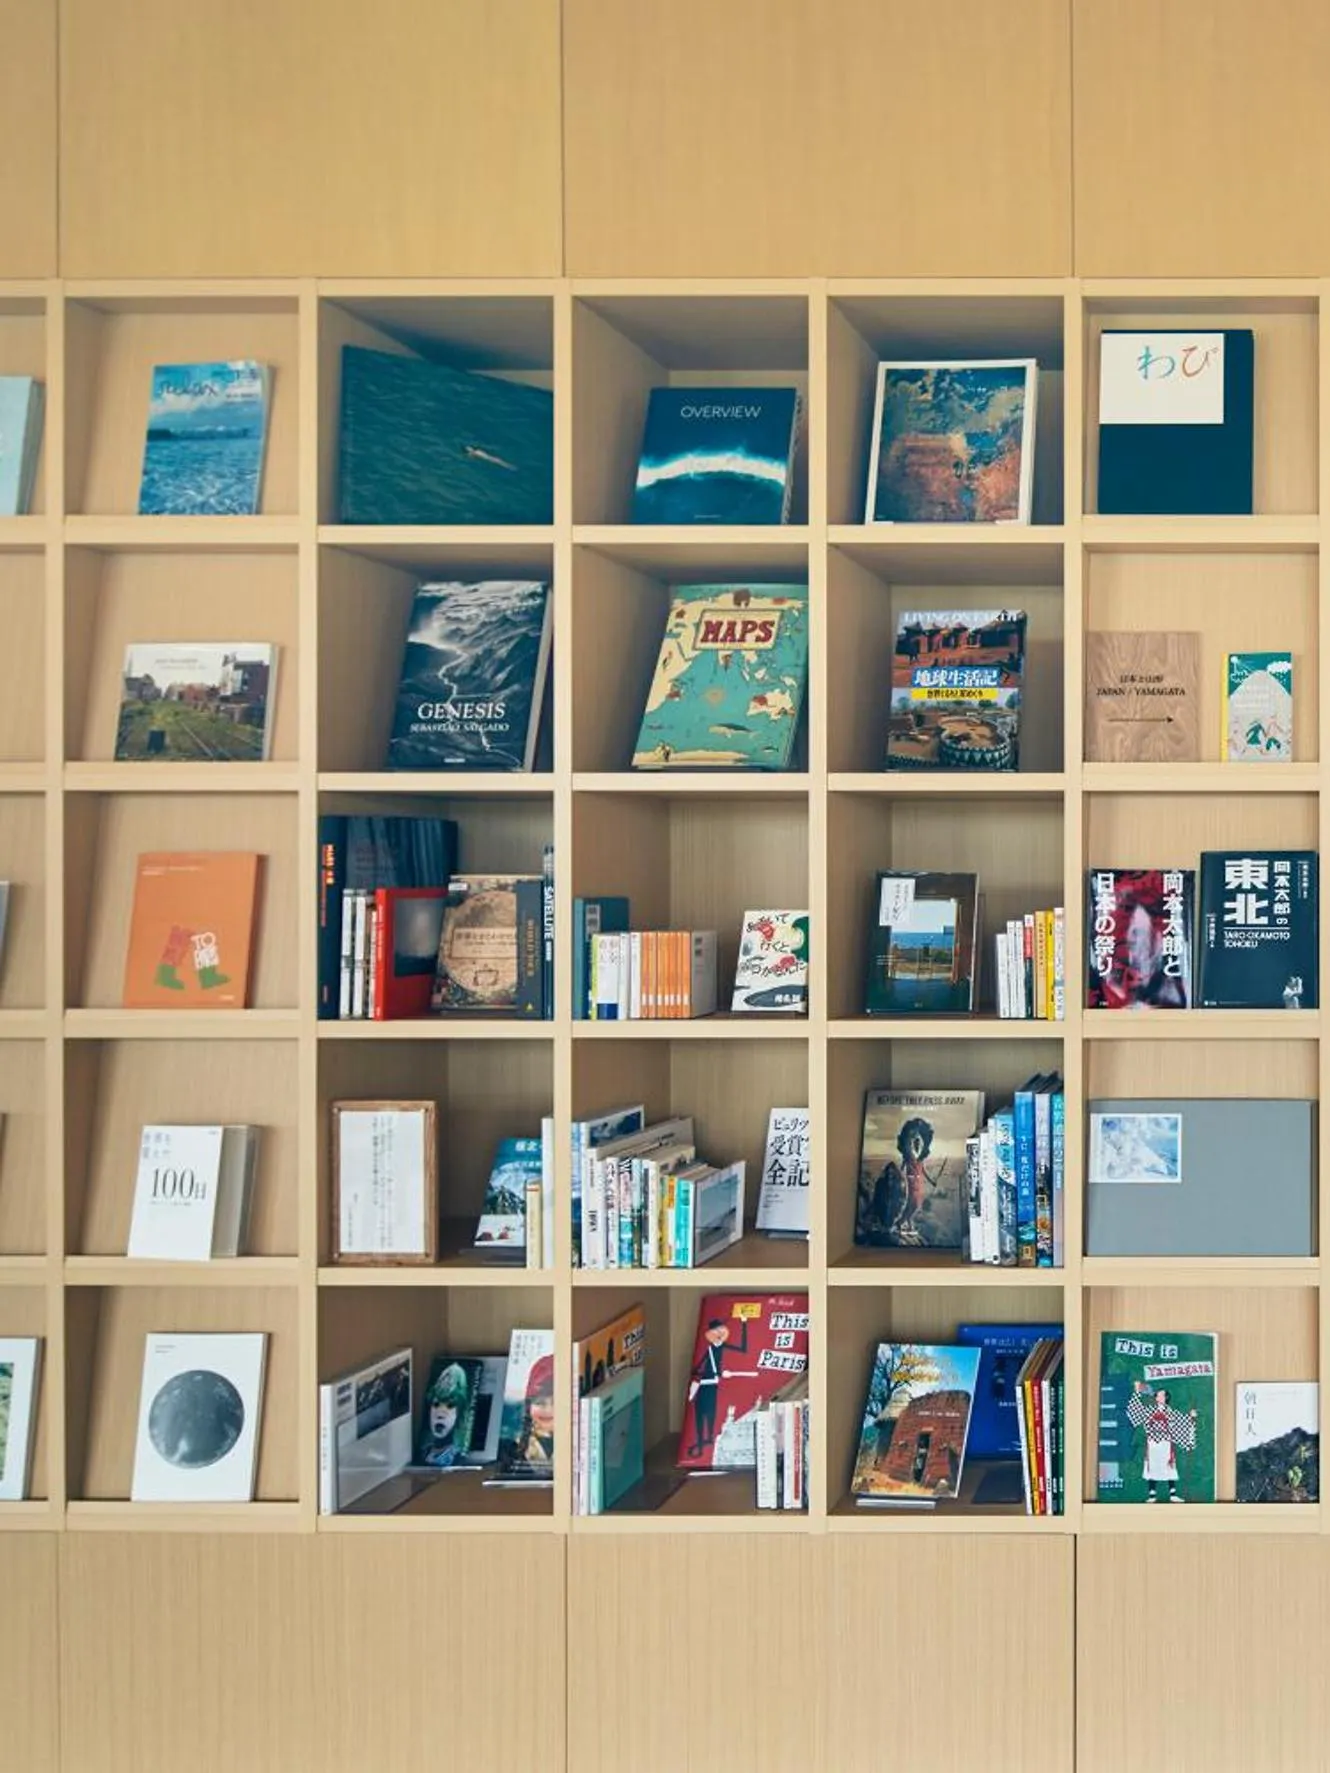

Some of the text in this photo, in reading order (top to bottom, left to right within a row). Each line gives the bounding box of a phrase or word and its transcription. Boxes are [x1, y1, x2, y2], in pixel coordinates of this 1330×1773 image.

[1137, 345, 1220, 380] わび
[681, 405, 761, 419] OVERVIEW
[702, 619, 776, 643] MAPS
[914, 669, 998, 687] 地球生活記
[1096, 687, 1126, 696] JAPAN
[1135, 686, 1186, 696] YAMAGATA
[418, 702, 506, 720] GENESIS
[1224, 858, 1269, 925] 東北
[1273, 861, 1290, 925] 岡本太郎の
[1095, 872, 1116, 976] 日本の祭り
[1163, 872, 1184, 977] 岡本太郎と
[770, 1135, 809, 1157] 受賞
[765, 1159, 809, 1187] 全記
[773, 1315, 809, 1329] This
[777, 1335, 791, 1347] is
[1118, 1340, 1176, 1357] This is
[761, 1351, 805, 1370] Paris
[1148, 1366, 1210, 1378] Yamagata
